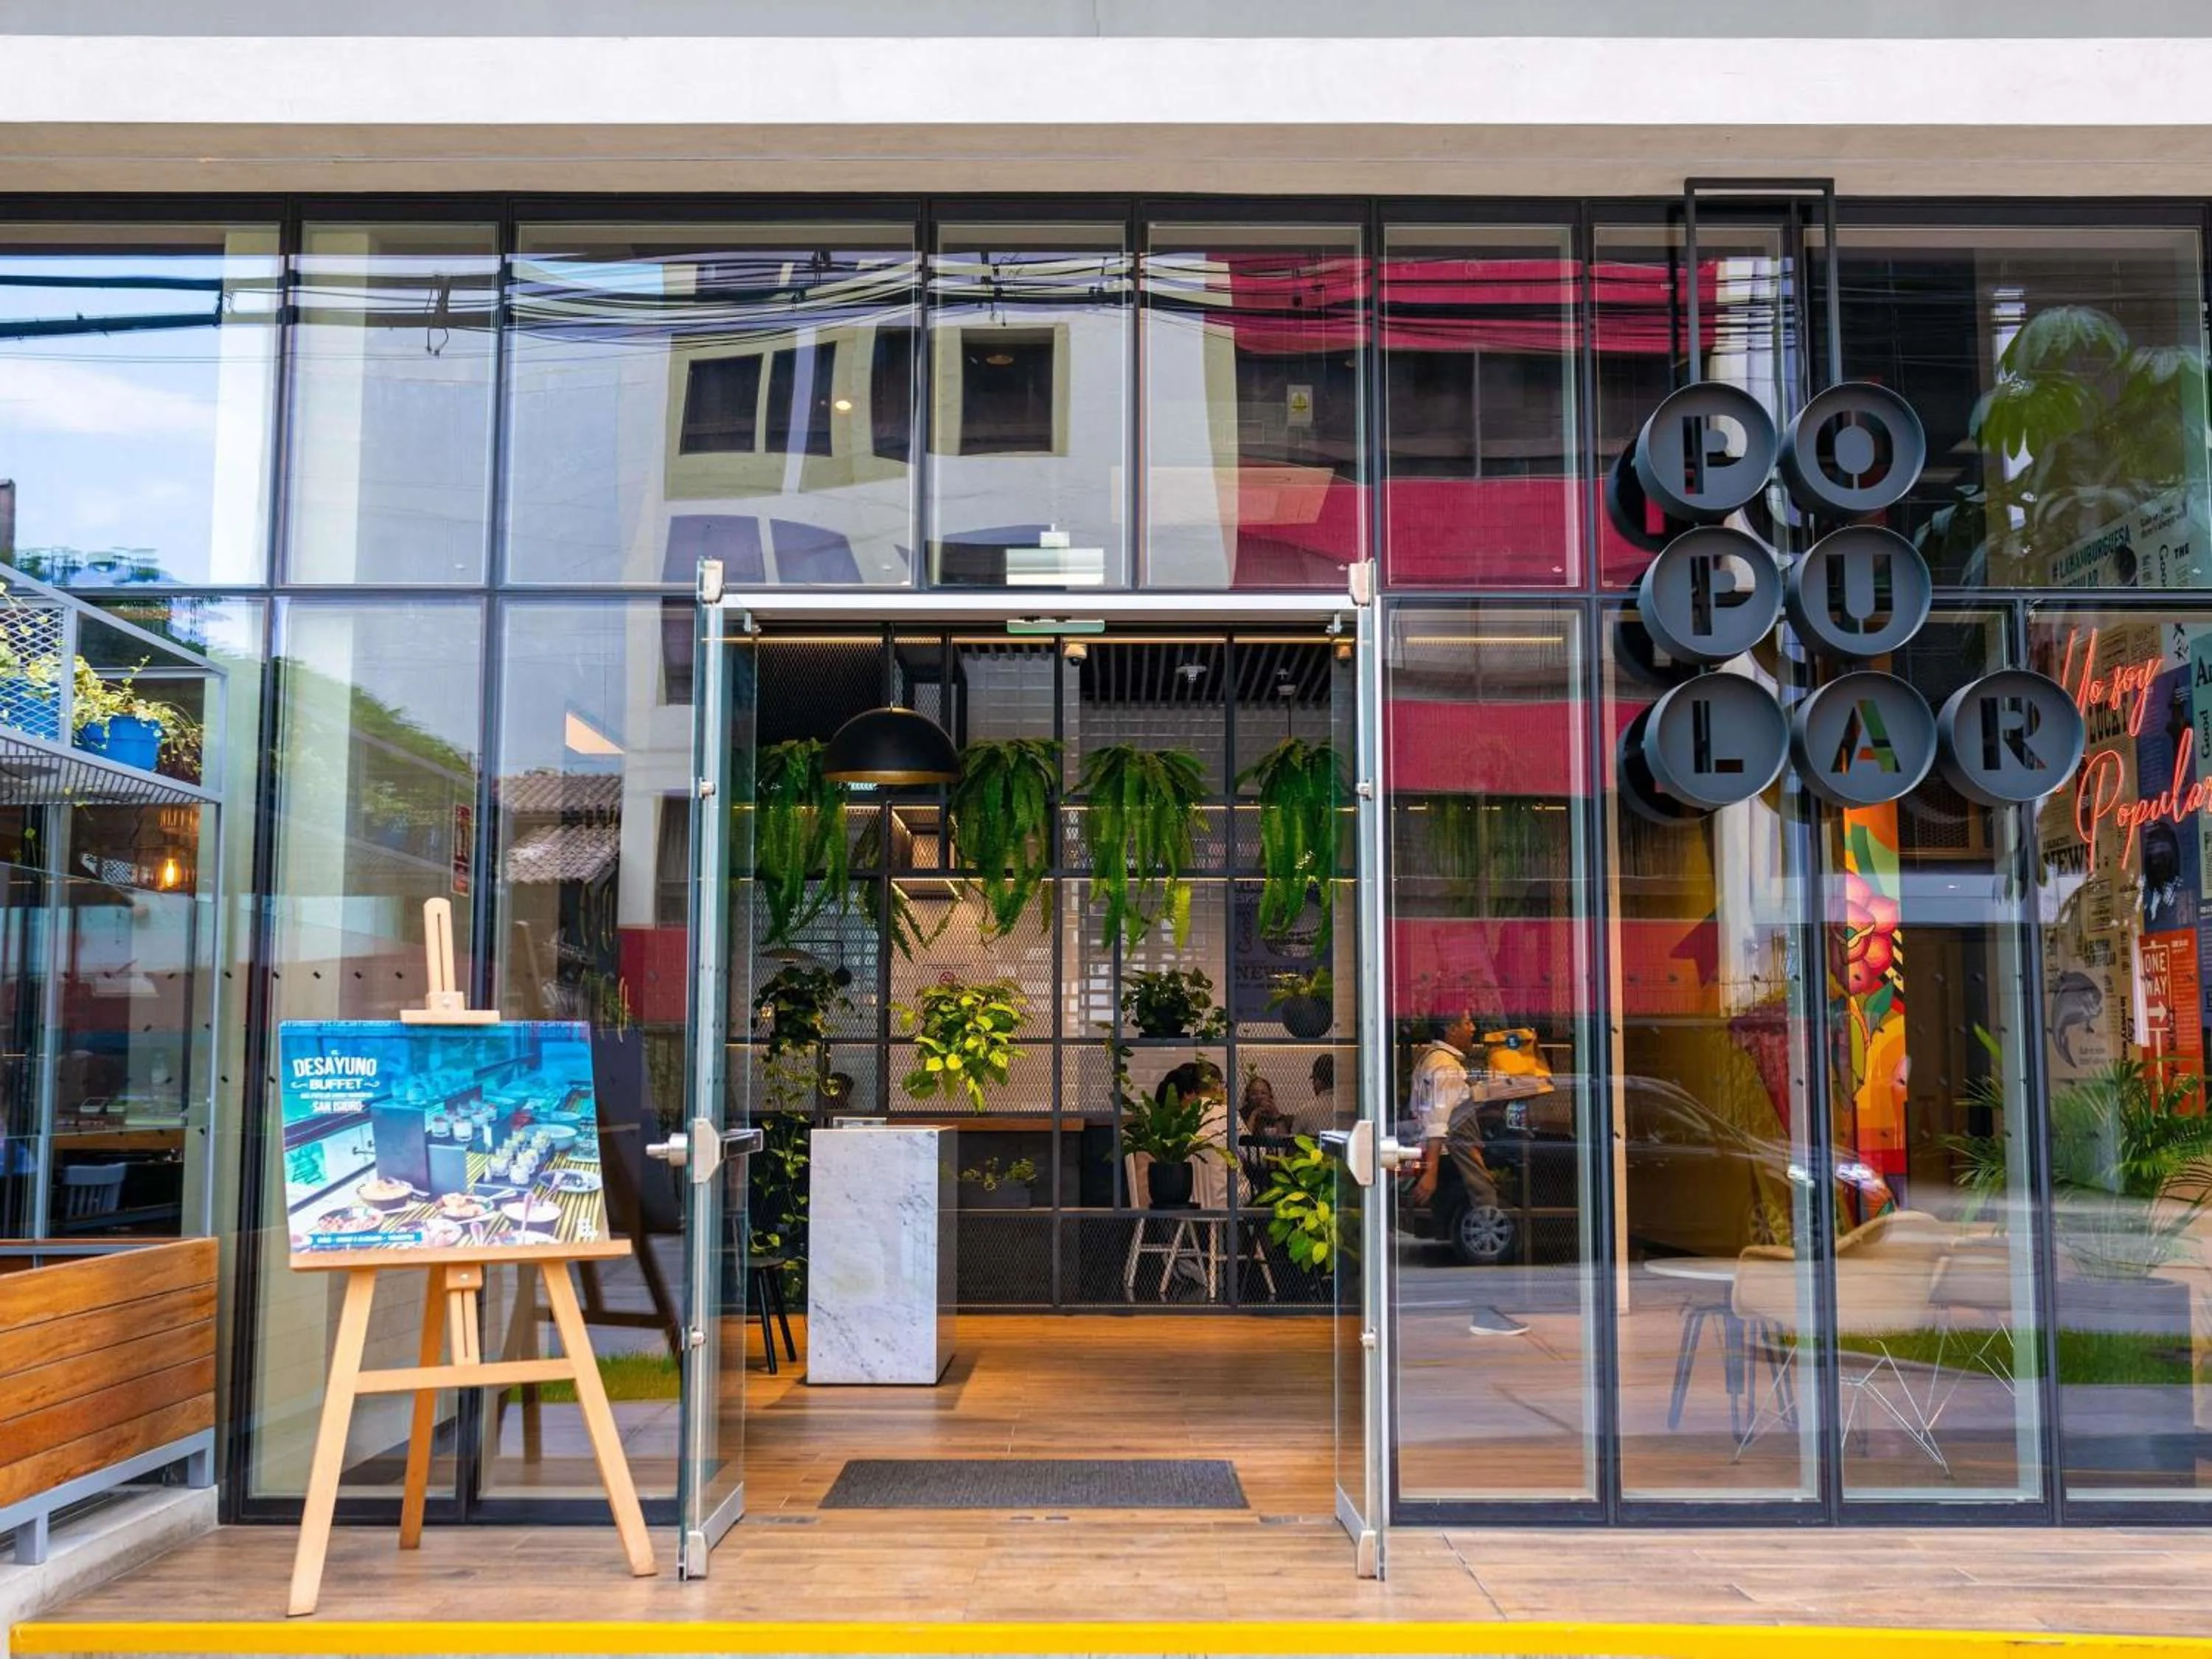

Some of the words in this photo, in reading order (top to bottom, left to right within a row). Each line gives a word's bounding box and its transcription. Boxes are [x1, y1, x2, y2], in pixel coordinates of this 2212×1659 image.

[2144, 953, 2167, 972] ONE
[2143, 975, 2168, 997] WAY
[293, 1056, 377, 1077] DESAYUNO
[309, 1079, 363, 1090] BUFFET
